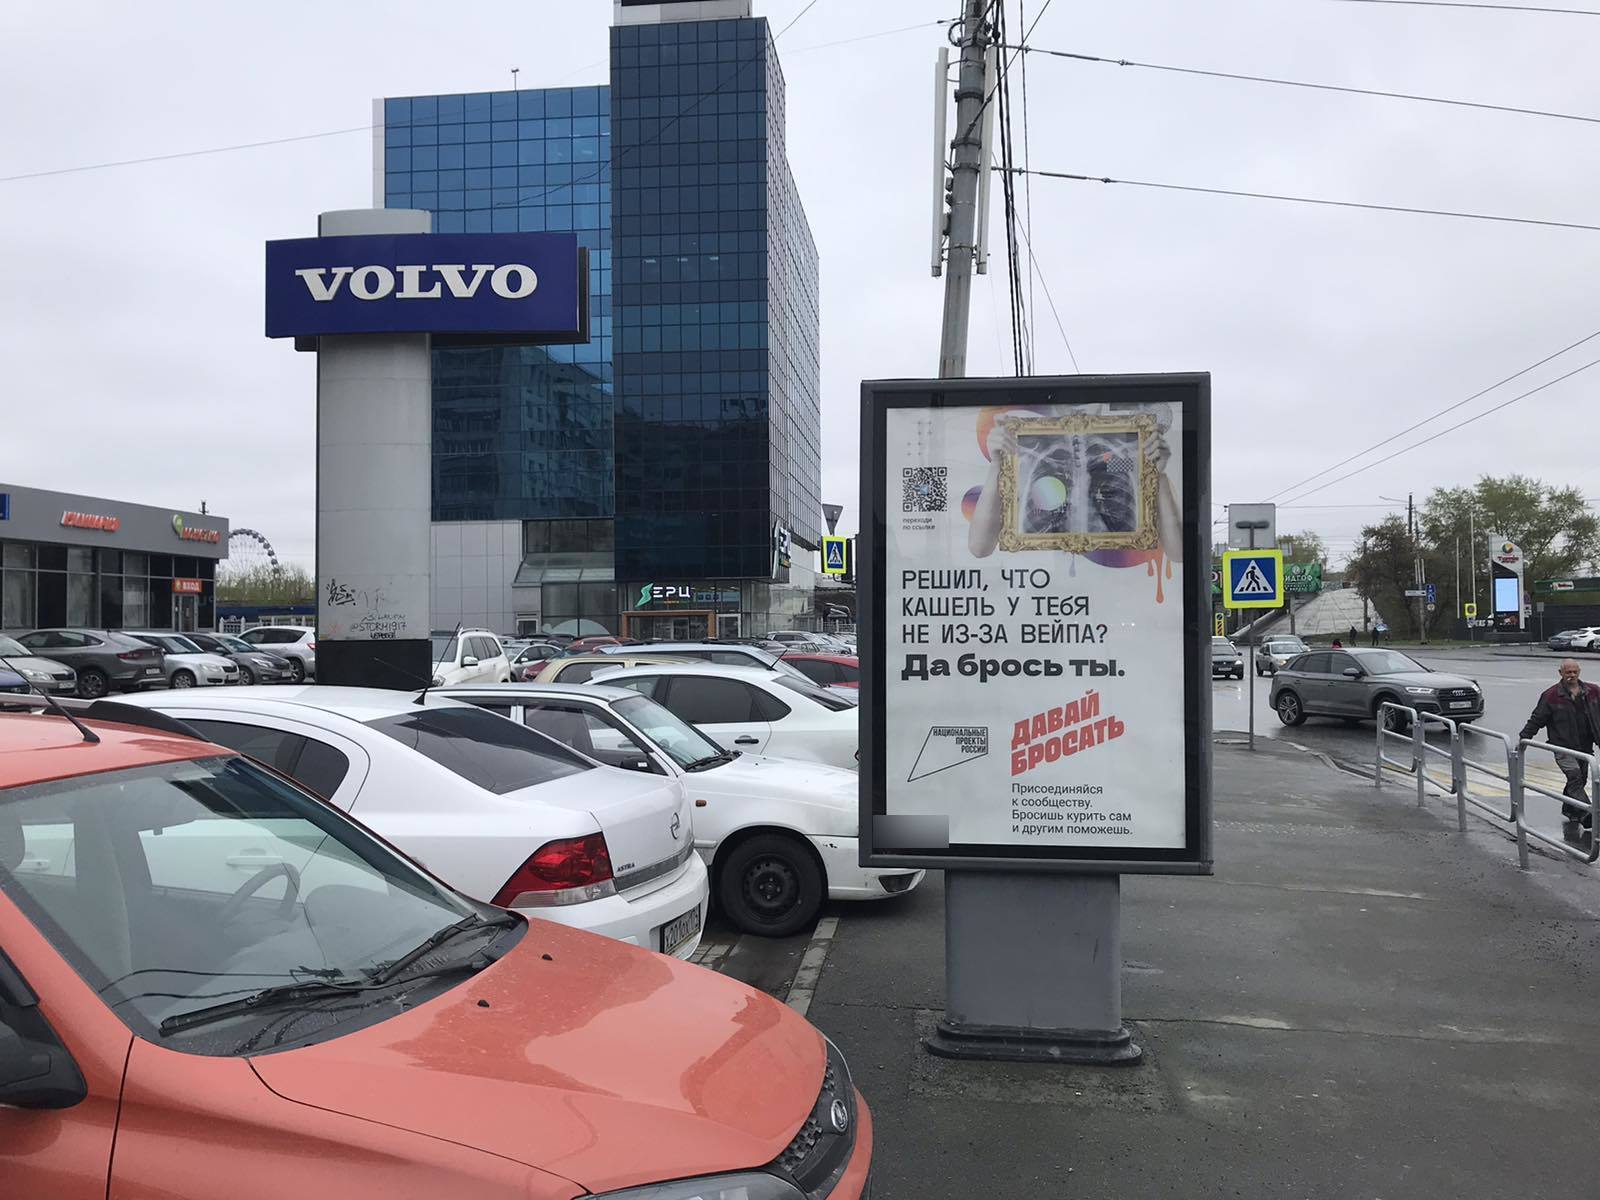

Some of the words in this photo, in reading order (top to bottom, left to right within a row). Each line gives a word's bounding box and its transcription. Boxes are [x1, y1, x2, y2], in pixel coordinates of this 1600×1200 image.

[295, 264, 538, 301] VOLVO
[902, 569, 989, 592] РЕШИЛ,
[1001, 568, 1051, 590] ЧТО
[902, 596, 996, 617] КАШЕЛЬ
[1007, 596, 1020, 617] У
[902, 624, 930, 645] НЕ
[941, 623, 1009, 644] ИЗ-ЗА
[1020, 618, 1108, 644] ВЕЙПА?
[901, 654, 951, 682] Да
[957, 653, 1063, 683] брось
[1069, 659, 1126, 677] ты.
[1011, 689, 1101, 751] ДАВАЙ
[932, 728, 986, 737] НАЦИОНАЛЬНЫЕ
[955, 737, 986, 745] ПРОЕКТЫ
[961, 745, 986, 754] РОССИИ
[1011, 715, 1125, 777] БРОСАТЬ
[1012, 783, 1103, 796] Присоединяйся
[1012, 797, 1018, 806] к
[1021, 796, 1093, 810] сообществу.
[1012, 809, 1064, 821] Бросишь
[1067, 811, 1107, 823] курить
[1109, 812, 1131, 822] сам
[1012, 824, 1019, 833] и
[1022, 824, 1064, 836] другим
[1066, 825, 1133, 835] поможешь.
